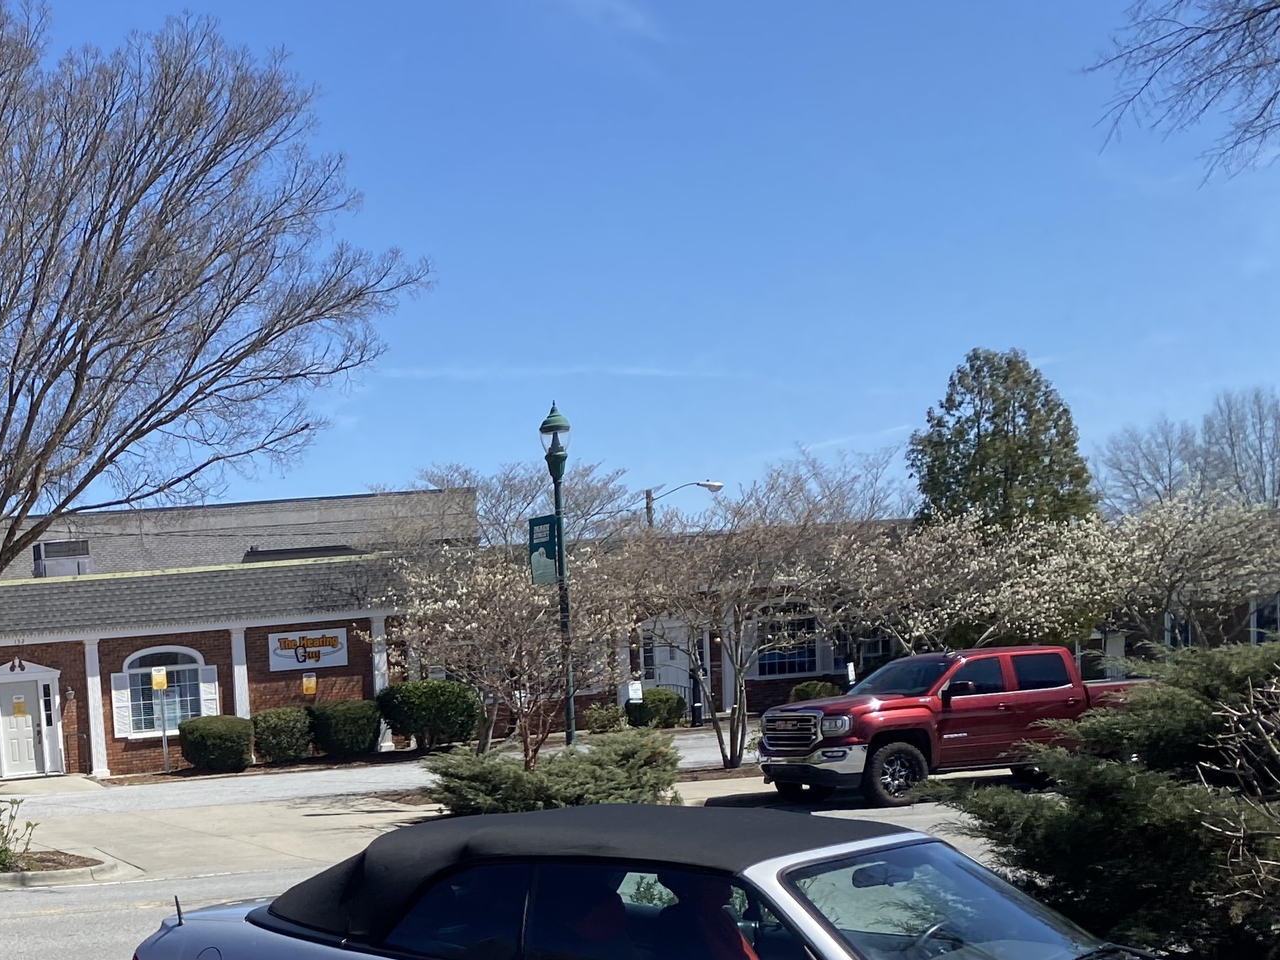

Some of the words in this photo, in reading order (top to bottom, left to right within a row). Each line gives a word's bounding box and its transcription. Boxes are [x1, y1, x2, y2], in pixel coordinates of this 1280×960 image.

[278, 638, 297, 650] The
[298, 634, 338, 648] Hearing
[295, 645, 320, 662] Guy
